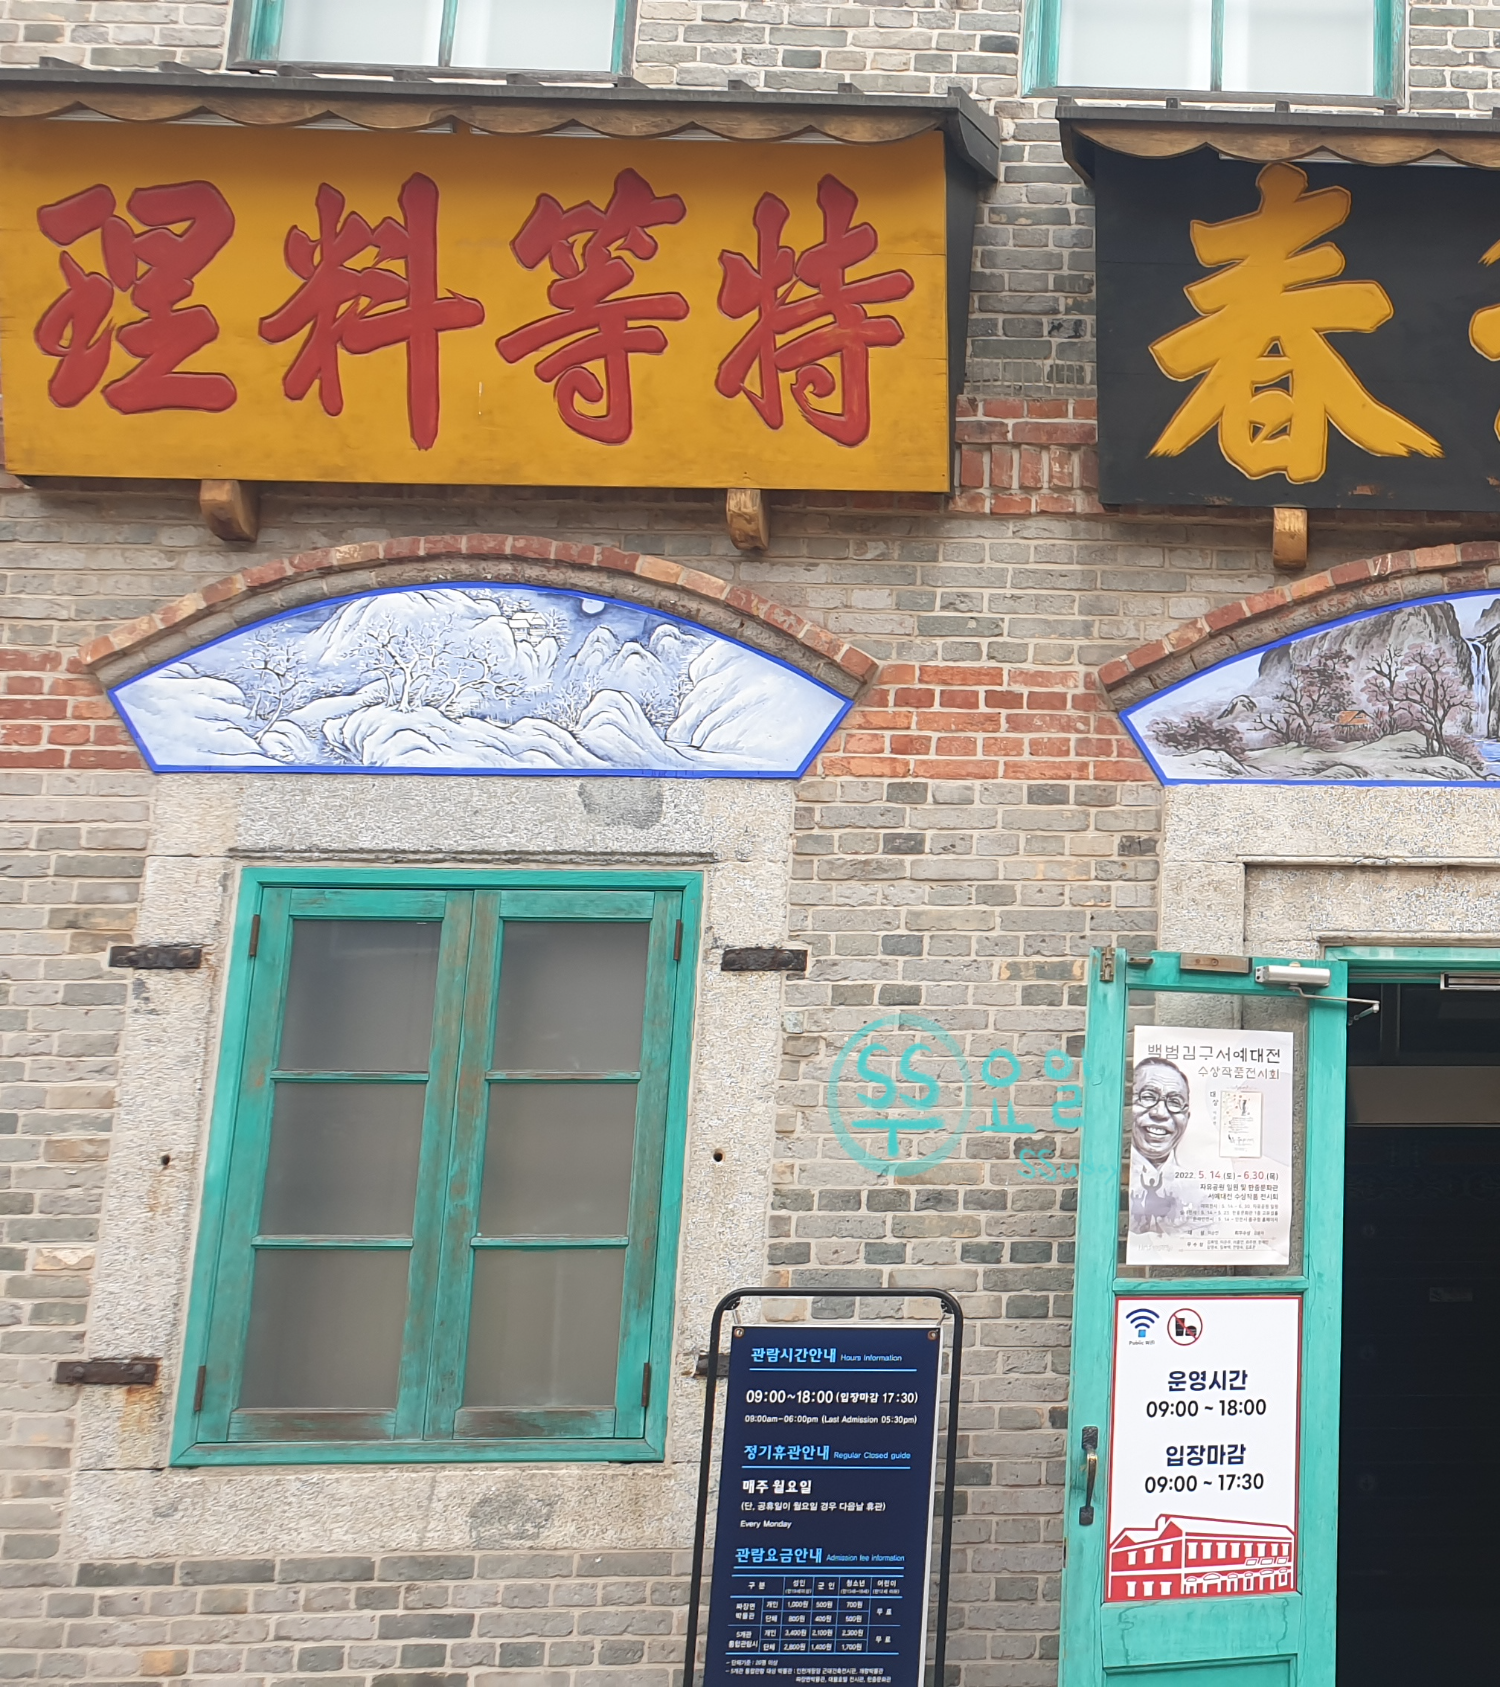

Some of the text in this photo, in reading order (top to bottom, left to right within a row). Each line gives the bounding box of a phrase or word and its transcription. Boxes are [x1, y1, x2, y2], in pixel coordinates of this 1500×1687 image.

[1197, 1065, 1280, 1080] 수상작품전시회
[751, 1348, 902, 1362] 관람시간안내 Hours Information
[1168, 1370, 1248, 1391] 운영시간
[746, 1390, 918, 1404] 09:00~18:00 (입장마감 17:30)
[1147, 1401, 1198, 1418] 09:00
[1219, 1399, 1266, 1416] 18:00
[745, 1414, 917, 1425] 09:00am-06:00pm (Last Admission 05:30pm)
[744, 1445, 911, 1461] 정기휴관안내 Regular Closed guide
[1166, 1444, 1246, 1466] 입장마감
[743, 1479, 811, 1494] 매주 월요일
[1145, 1475, 1197, 1493] 09:00
[1218, 1473, 1264, 1490] 17:30
[740, 1519, 792, 1529] Every Monday
[736, 1548, 904, 1563] 관람요금안내 Admission fee information
